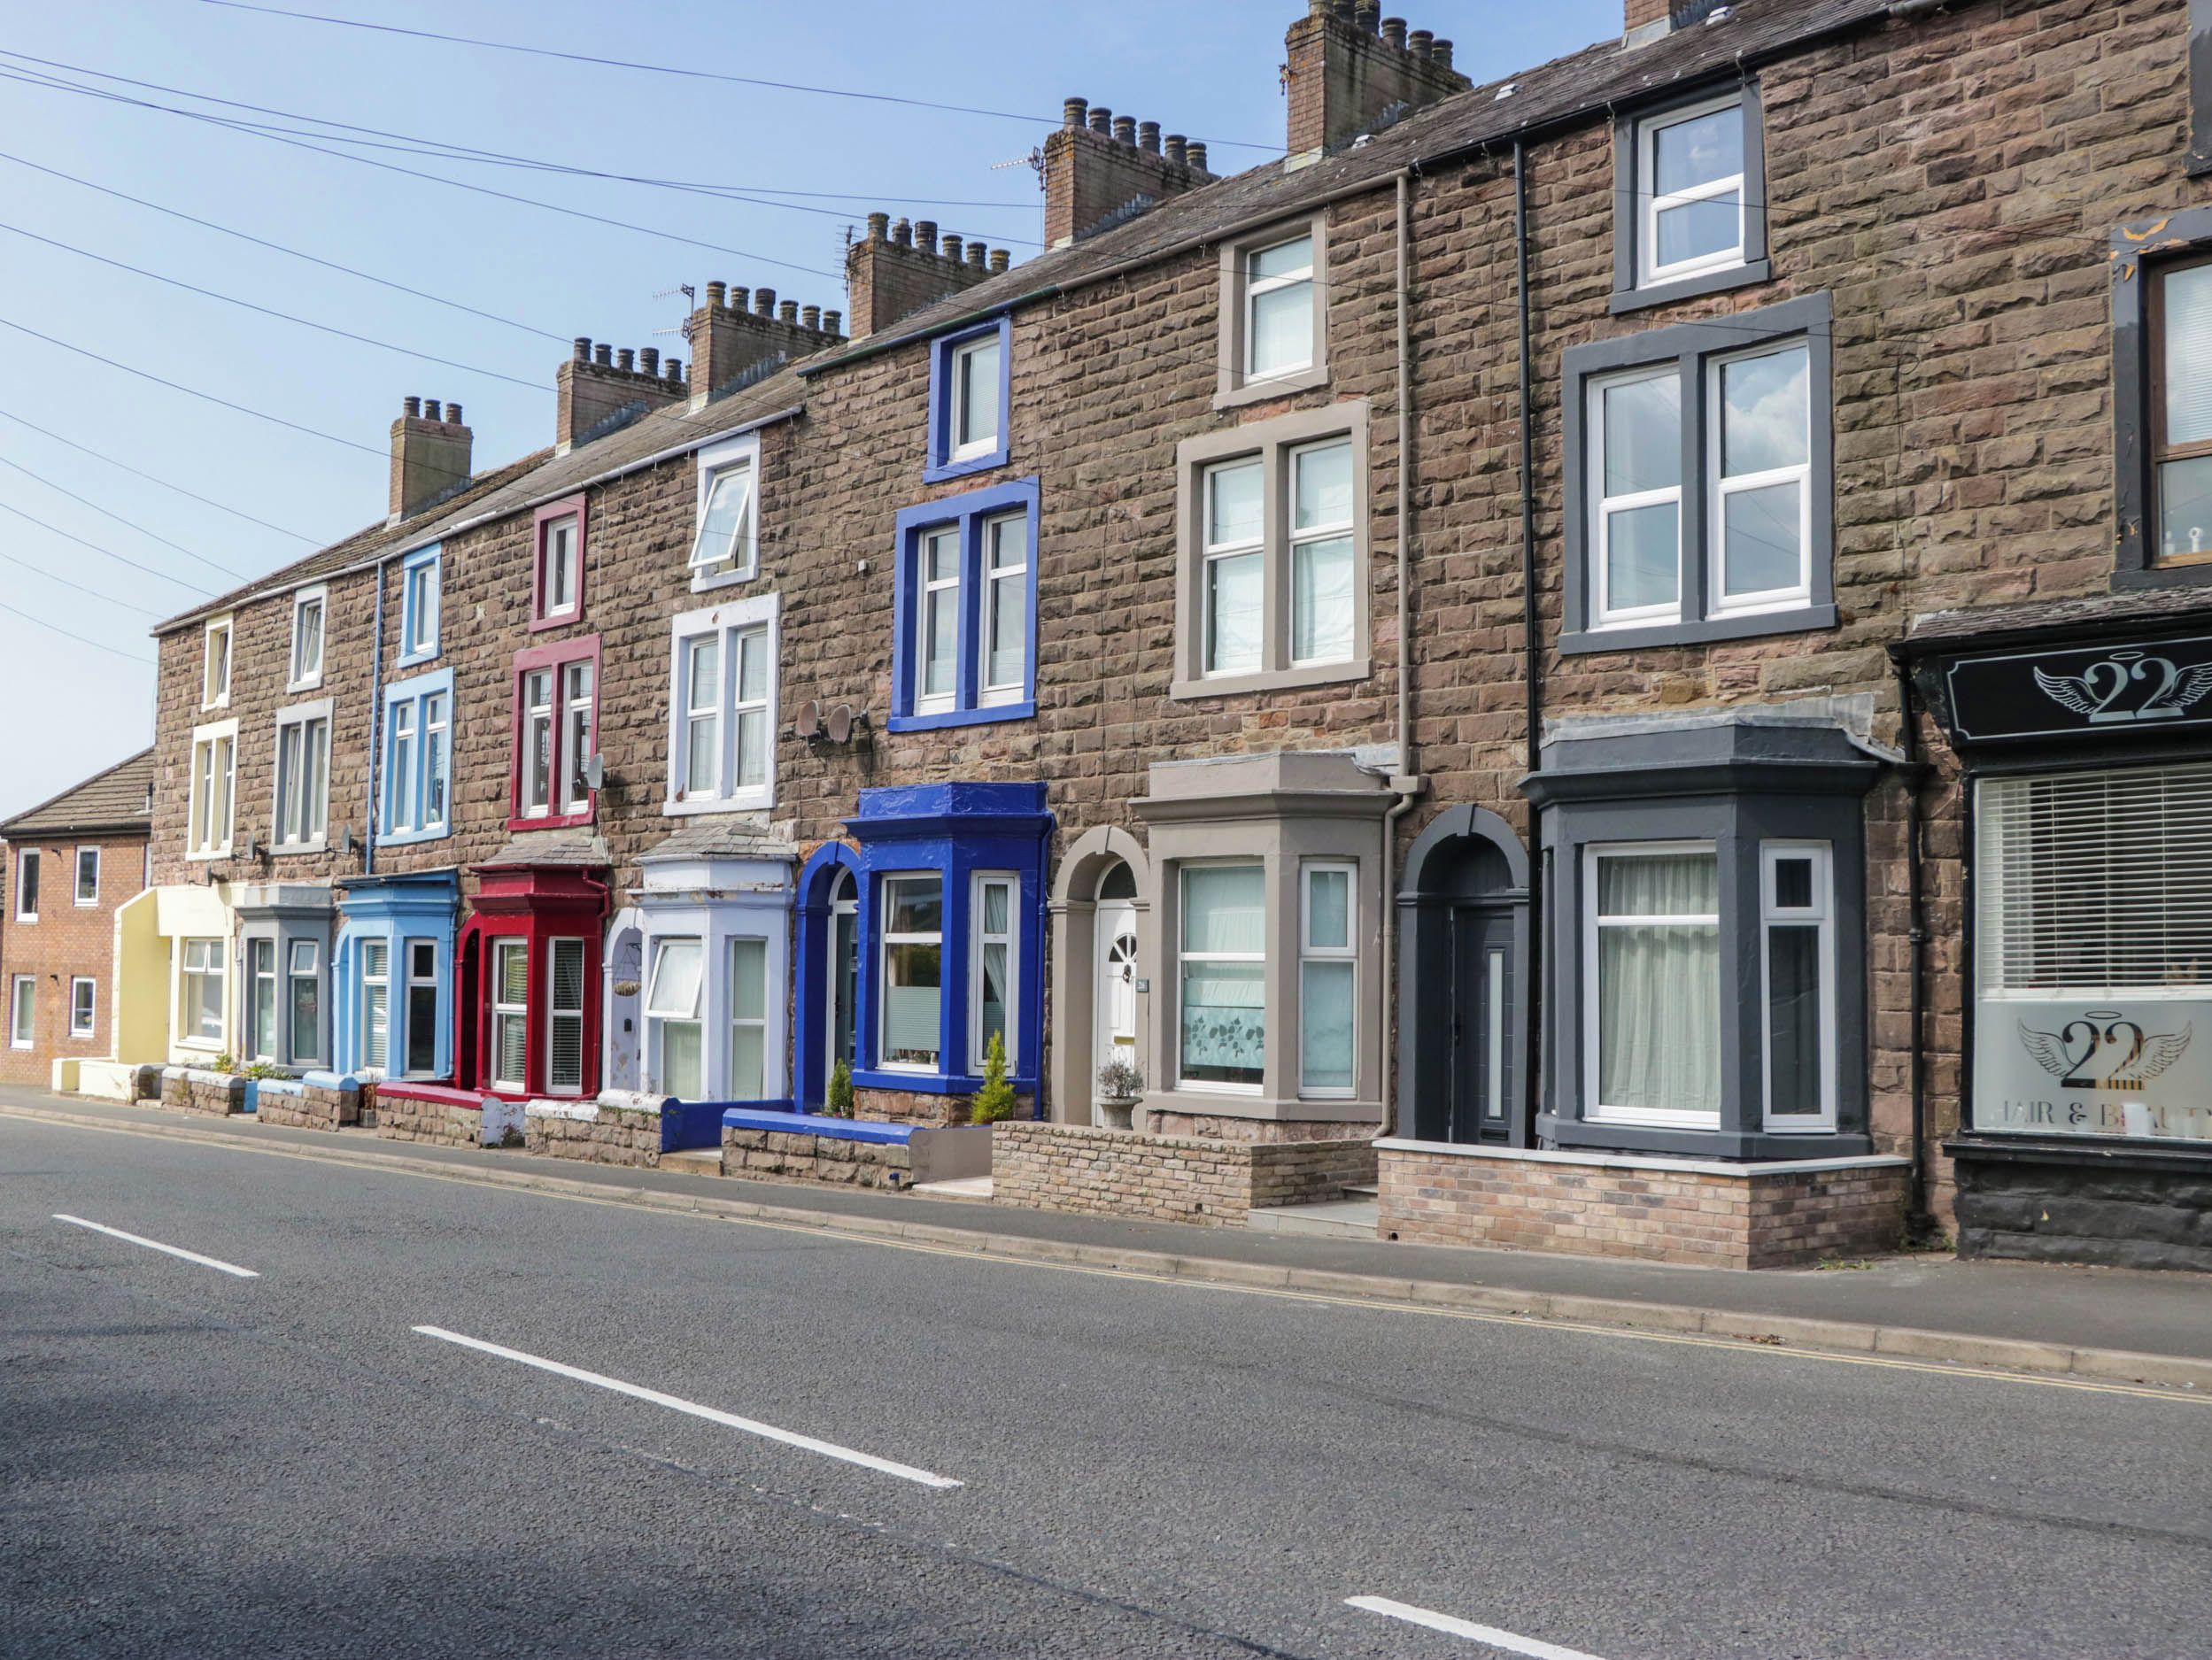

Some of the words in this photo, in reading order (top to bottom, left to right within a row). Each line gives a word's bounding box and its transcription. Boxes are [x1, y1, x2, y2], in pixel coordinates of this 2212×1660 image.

[2084, 657, 2185, 723] 22
[2061, 1021, 2146, 1091] 22
[2069, 1102, 2087, 1125] &
